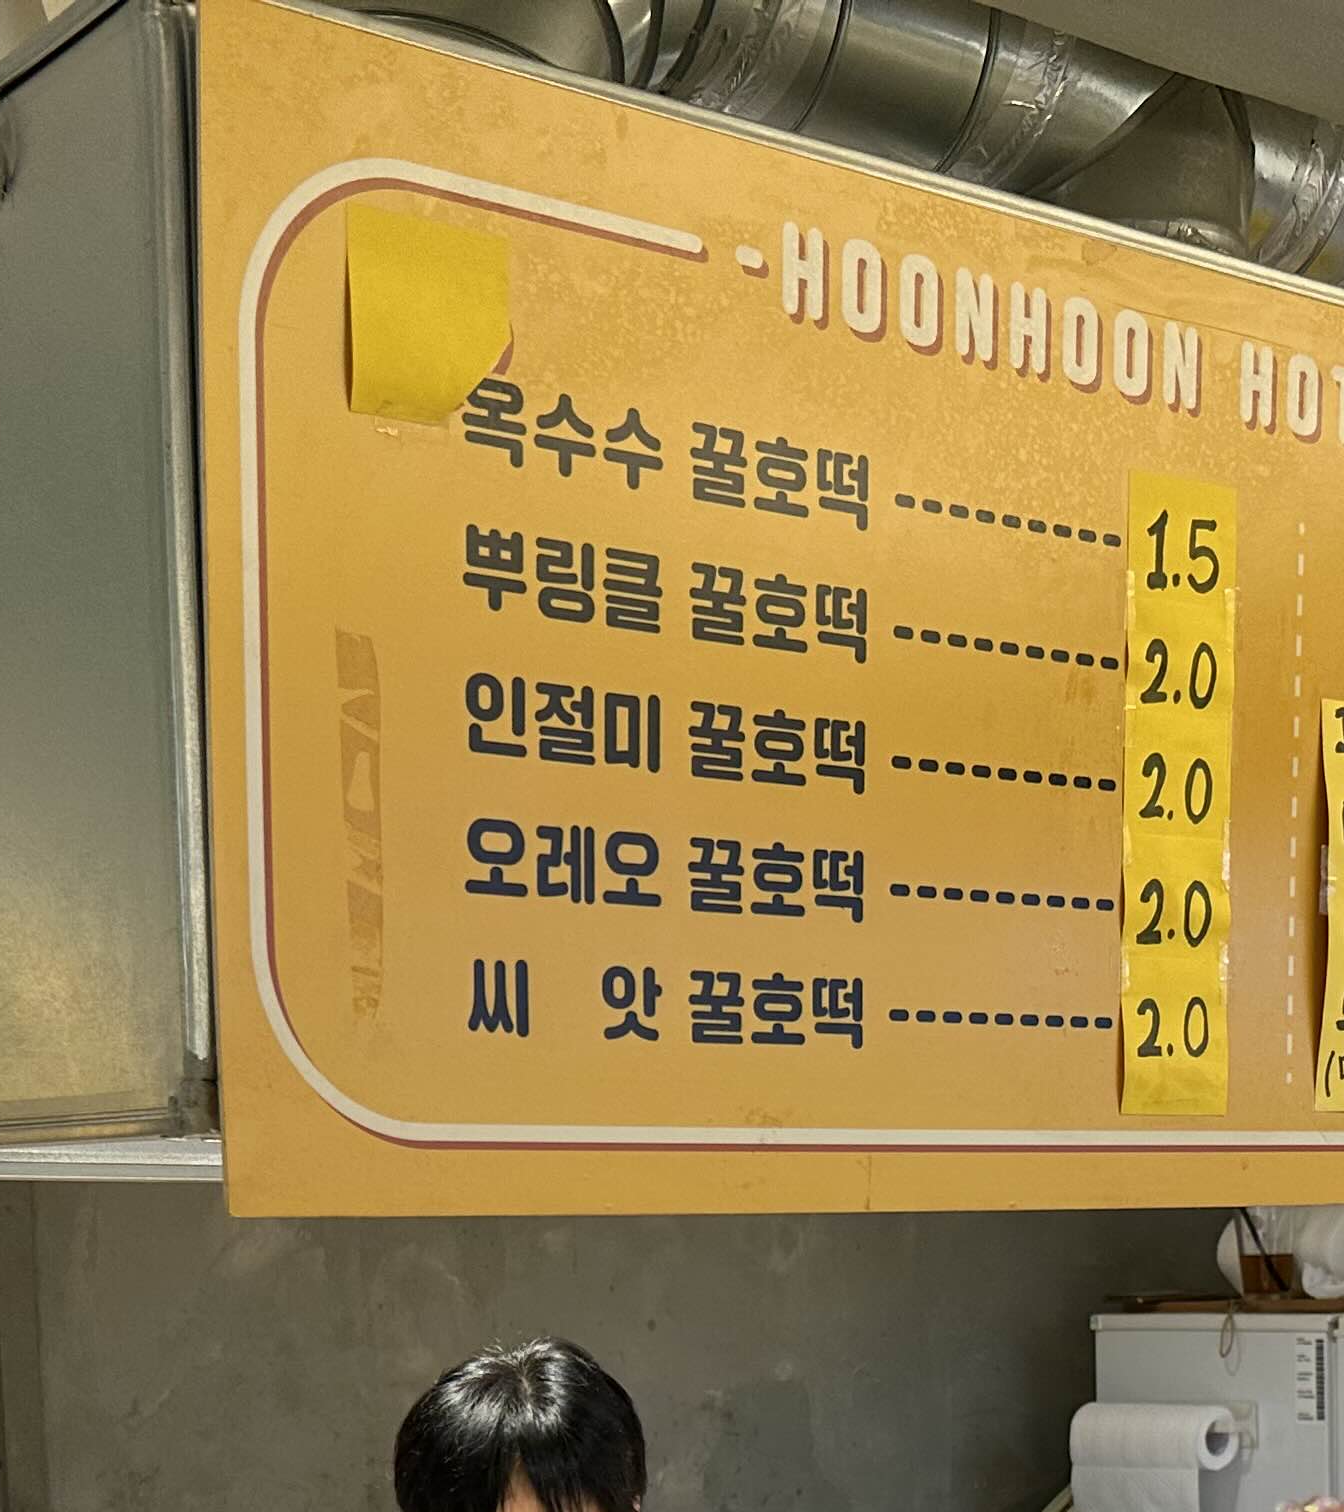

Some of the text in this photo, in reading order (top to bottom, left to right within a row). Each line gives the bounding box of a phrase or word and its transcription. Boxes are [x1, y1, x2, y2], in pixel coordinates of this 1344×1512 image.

[462, 377, 870, 531] 옥수수 꿀호떡
[1144, 508, 1222, 594] 1.5
[462, 523, 868, 663] 뿌링클 꿀호떡
[1139, 638, 1218, 708] 2.0
[464, 672, 867, 795] 인절미 꿀호떡
[1137, 752, 1214, 824] 2.0
[464, 819, 865, 922] 오레오 꿀호떡
[1135, 878, 1214, 946] 2.0
[688, 970, 864, 1048] 꿀호떡
[1136, 998, 1212, 1058] 2.0
